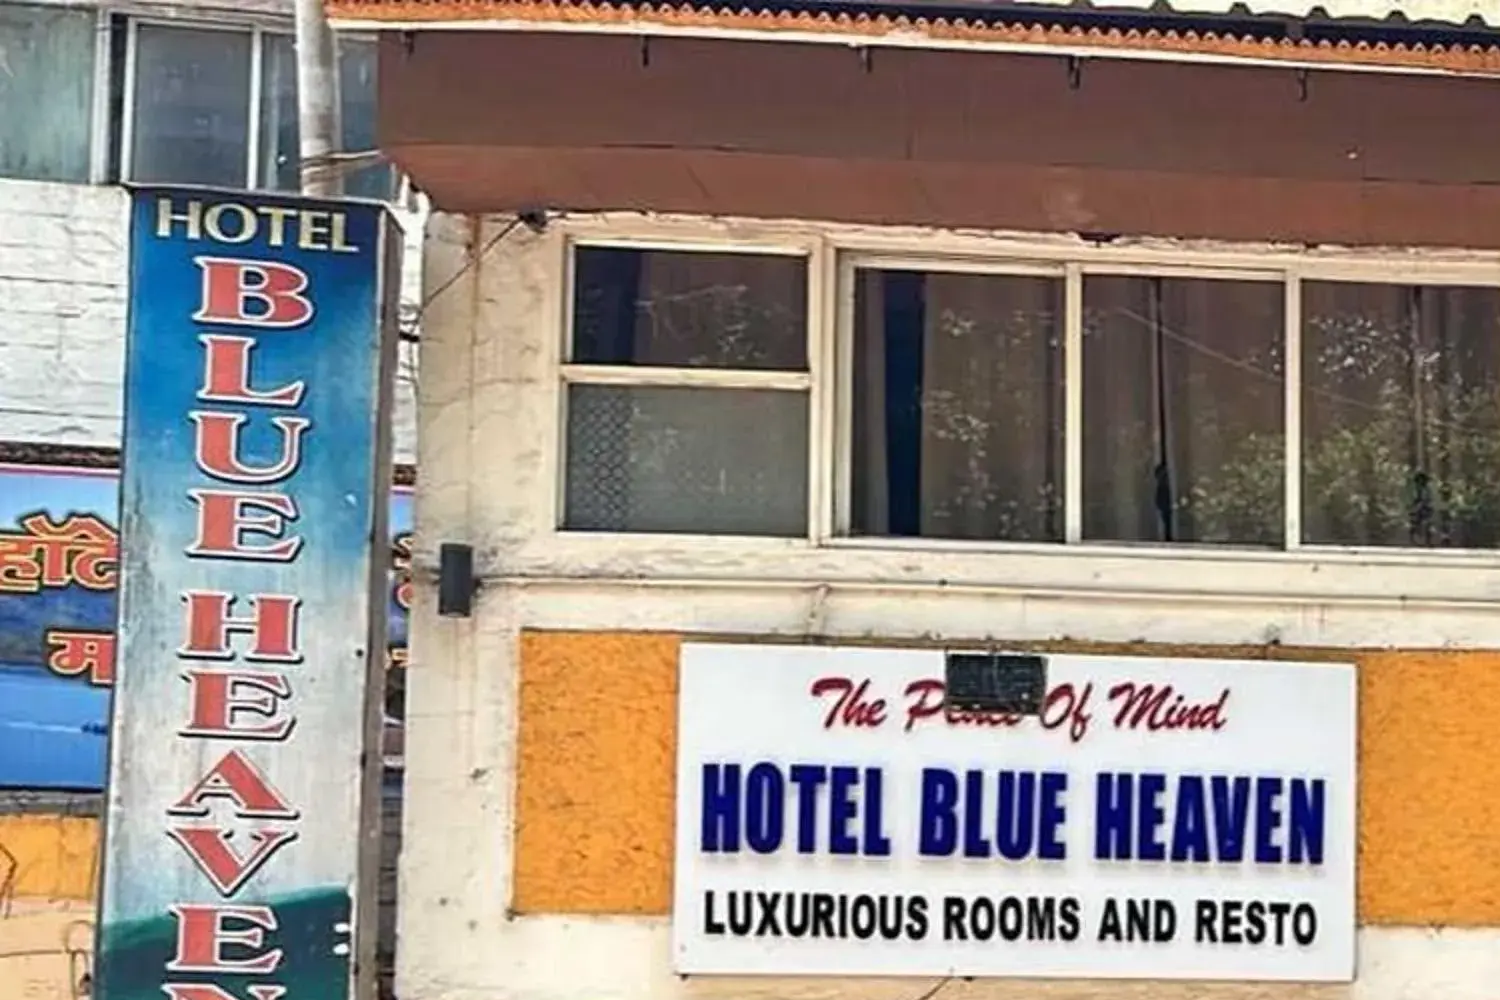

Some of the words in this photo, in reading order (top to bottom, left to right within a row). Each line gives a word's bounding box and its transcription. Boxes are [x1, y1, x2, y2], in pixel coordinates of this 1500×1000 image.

[156, 199, 359, 252] HOTEL
[184, 255, 315, 562] BLUE
[811, 677, 887, 729] The
[1038, 683, 1093, 742] Of
[1107, 682, 1231, 732] Mind
[701, 762, 890, 857] HOTEL
[919, 767, 1067, 862] BLUE
[1094, 772, 1326, 866] HEAVEN
[703, 890, 928, 943] LUXURIOUS
[943, 896, 1081, 943] ROOMS
[1098, 899, 1176, 943] AND
[1195, 902, 1318, 946] RESTO
